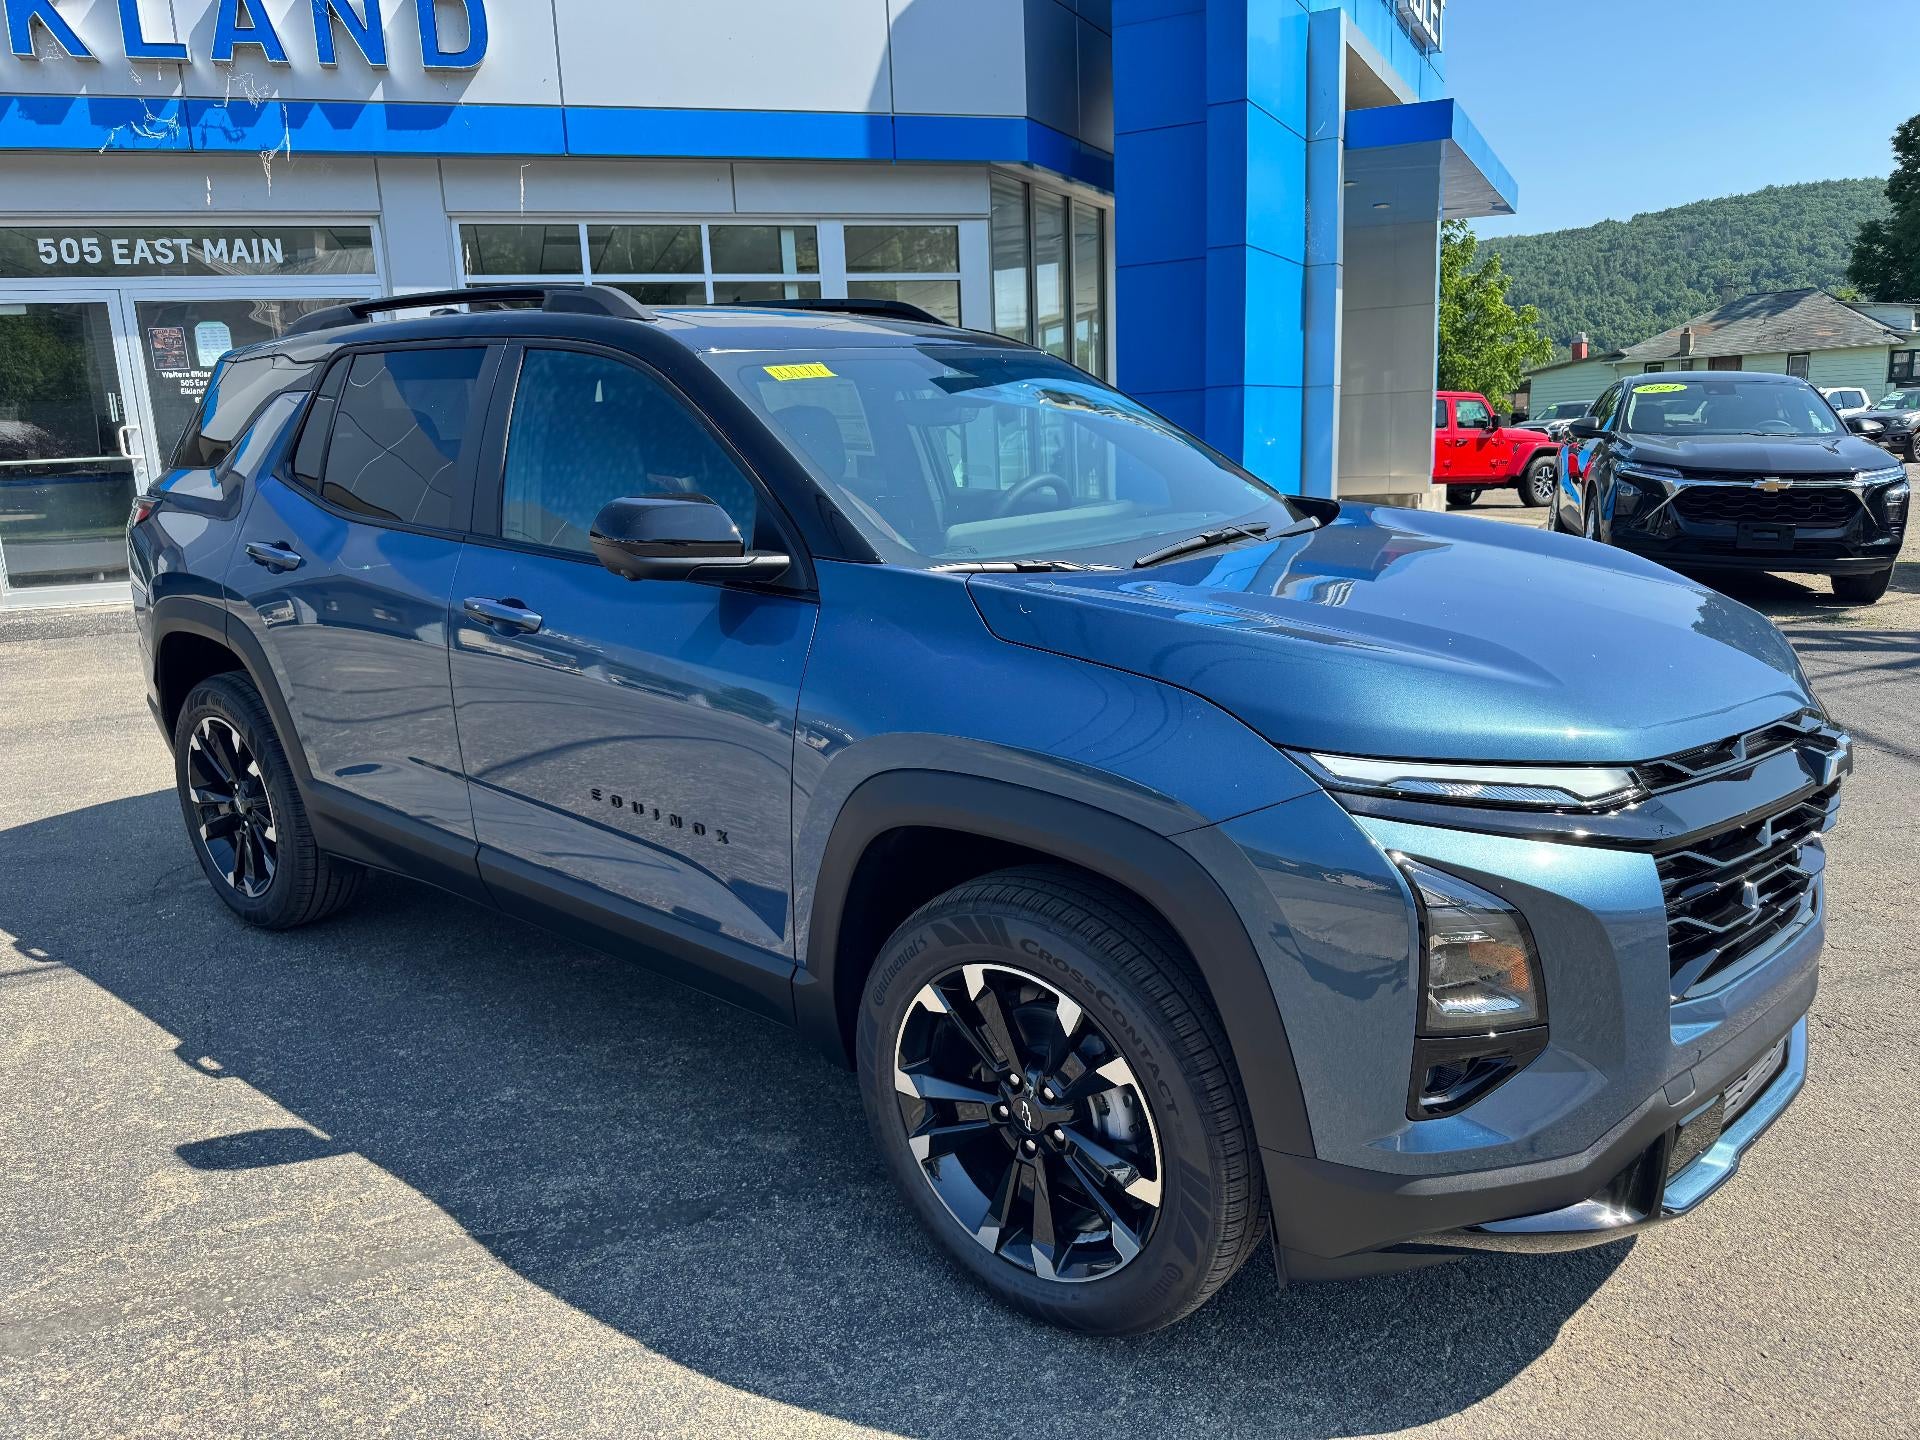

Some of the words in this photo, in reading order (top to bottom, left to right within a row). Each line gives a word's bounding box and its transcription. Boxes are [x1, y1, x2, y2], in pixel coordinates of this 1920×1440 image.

[37, 237, 102, 265] 505
[110, 238, 193, 265] EAST
[202, 238, 284, 264] MAIN
[180, 379, 195, 387] 505
[590, 788, 730, 845] EQUINOX
